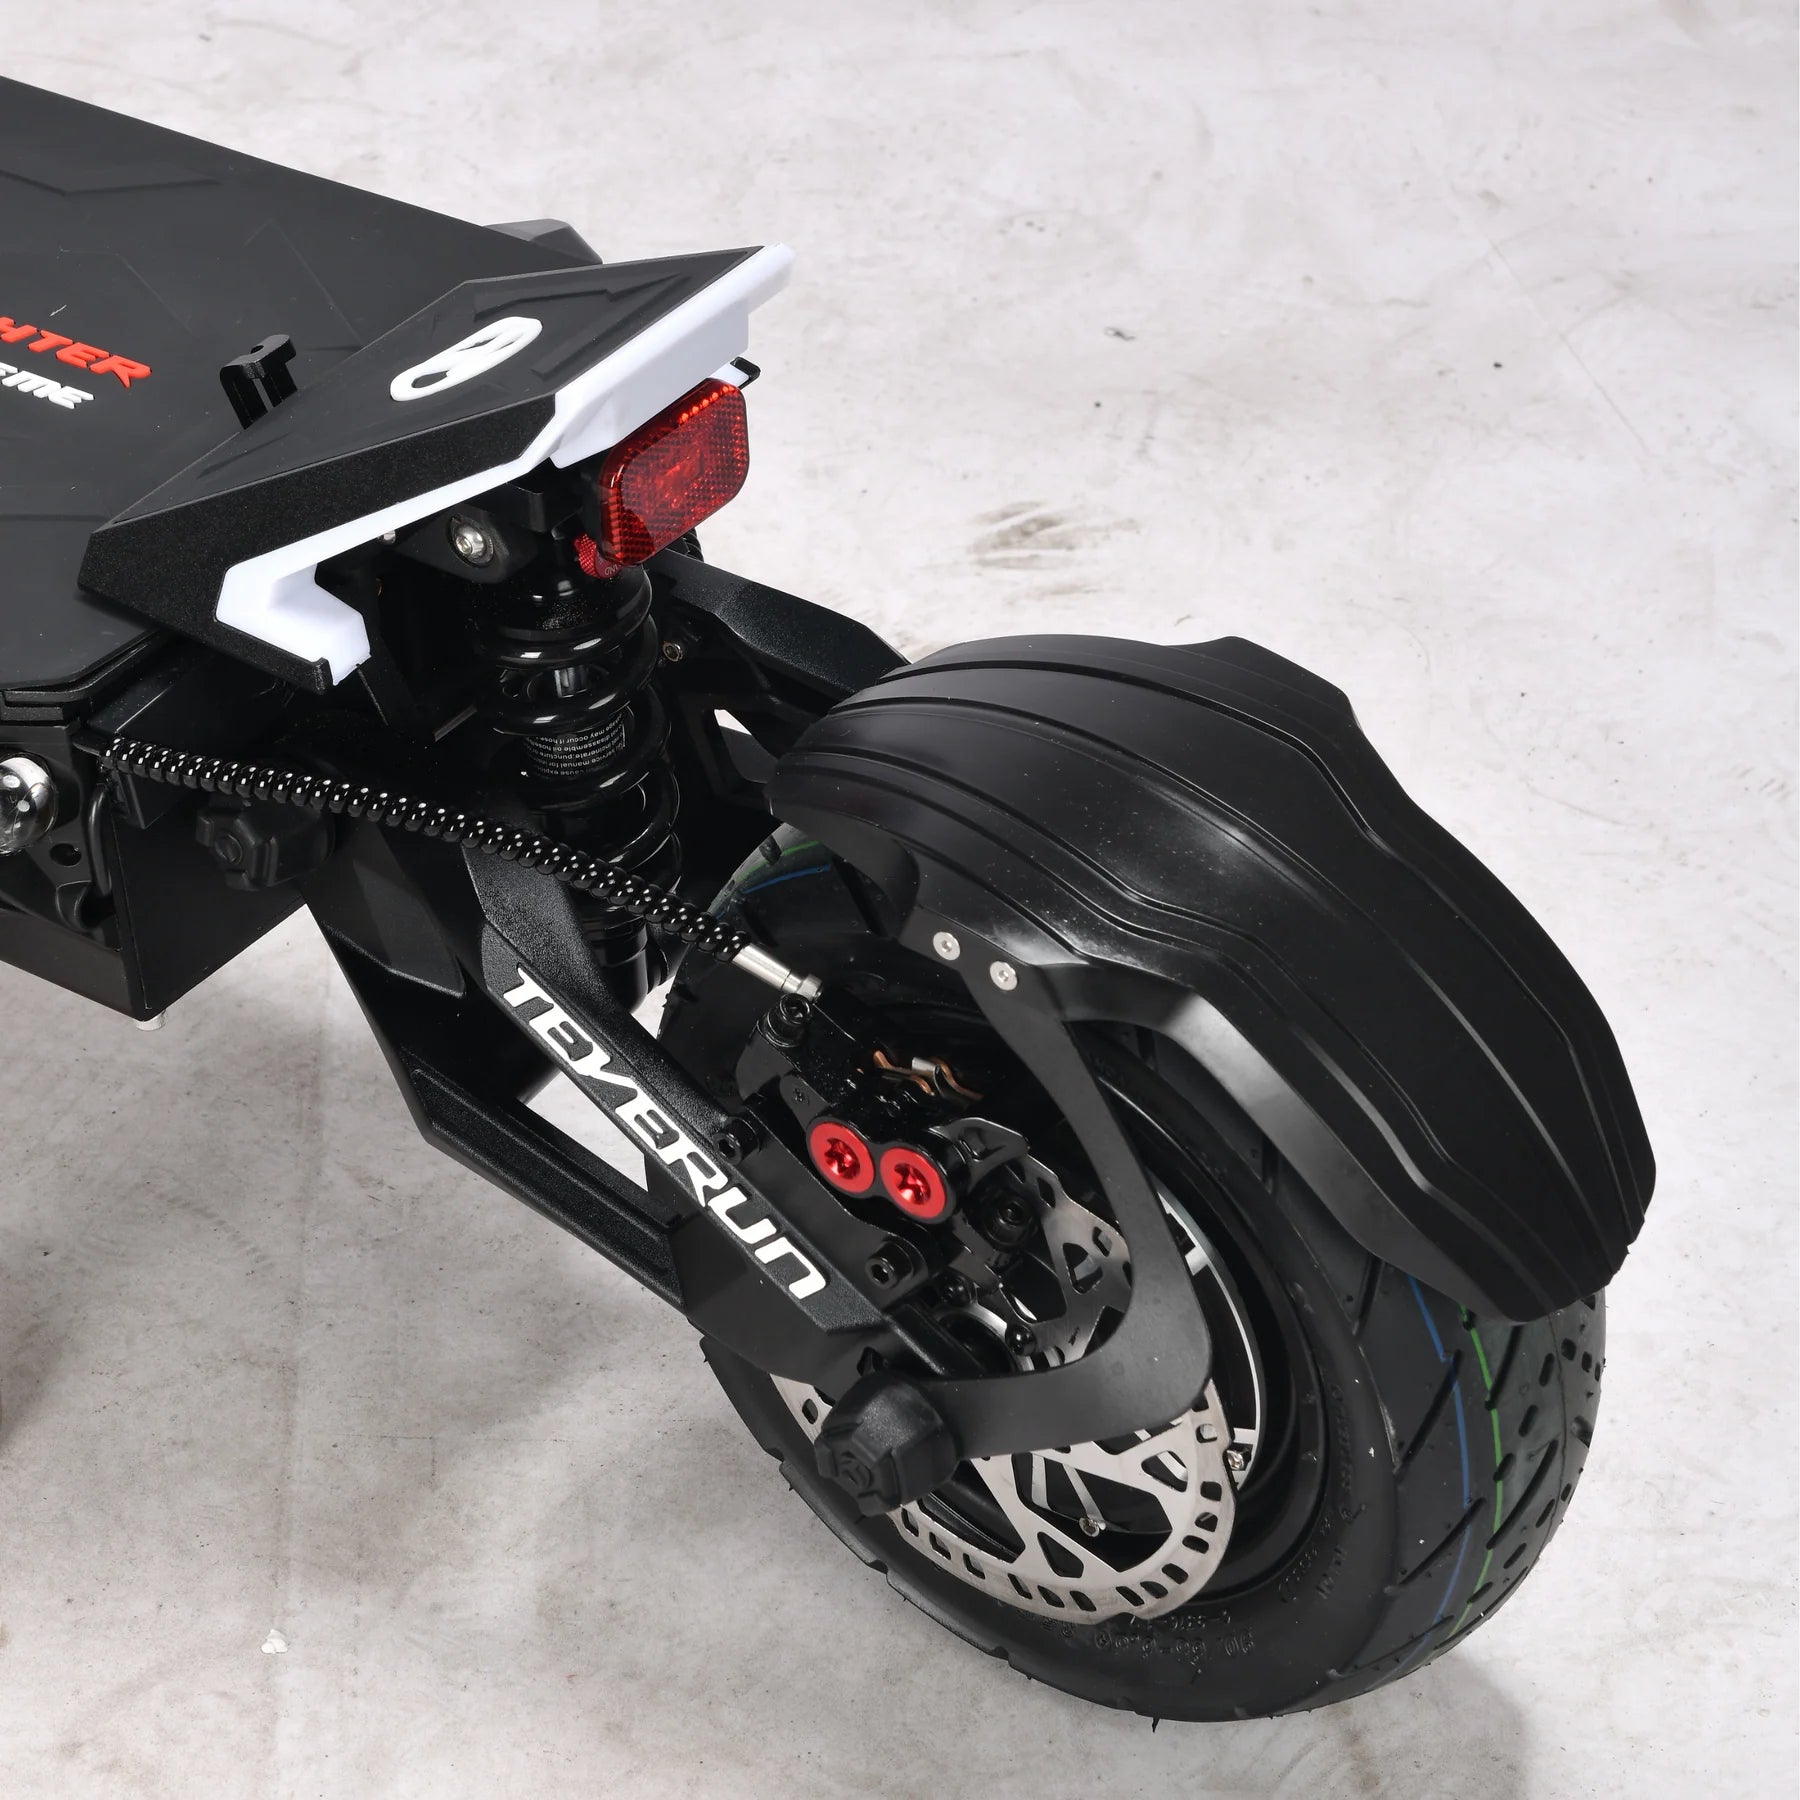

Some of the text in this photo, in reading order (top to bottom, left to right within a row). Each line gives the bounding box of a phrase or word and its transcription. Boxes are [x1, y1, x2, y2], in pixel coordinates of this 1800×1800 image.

[590, 730, 605, 738] may
[567, 735, 589, 743] occur
[560, 760, 590, 768] manual
[503, 967, 827, 1300] TEVERUN
